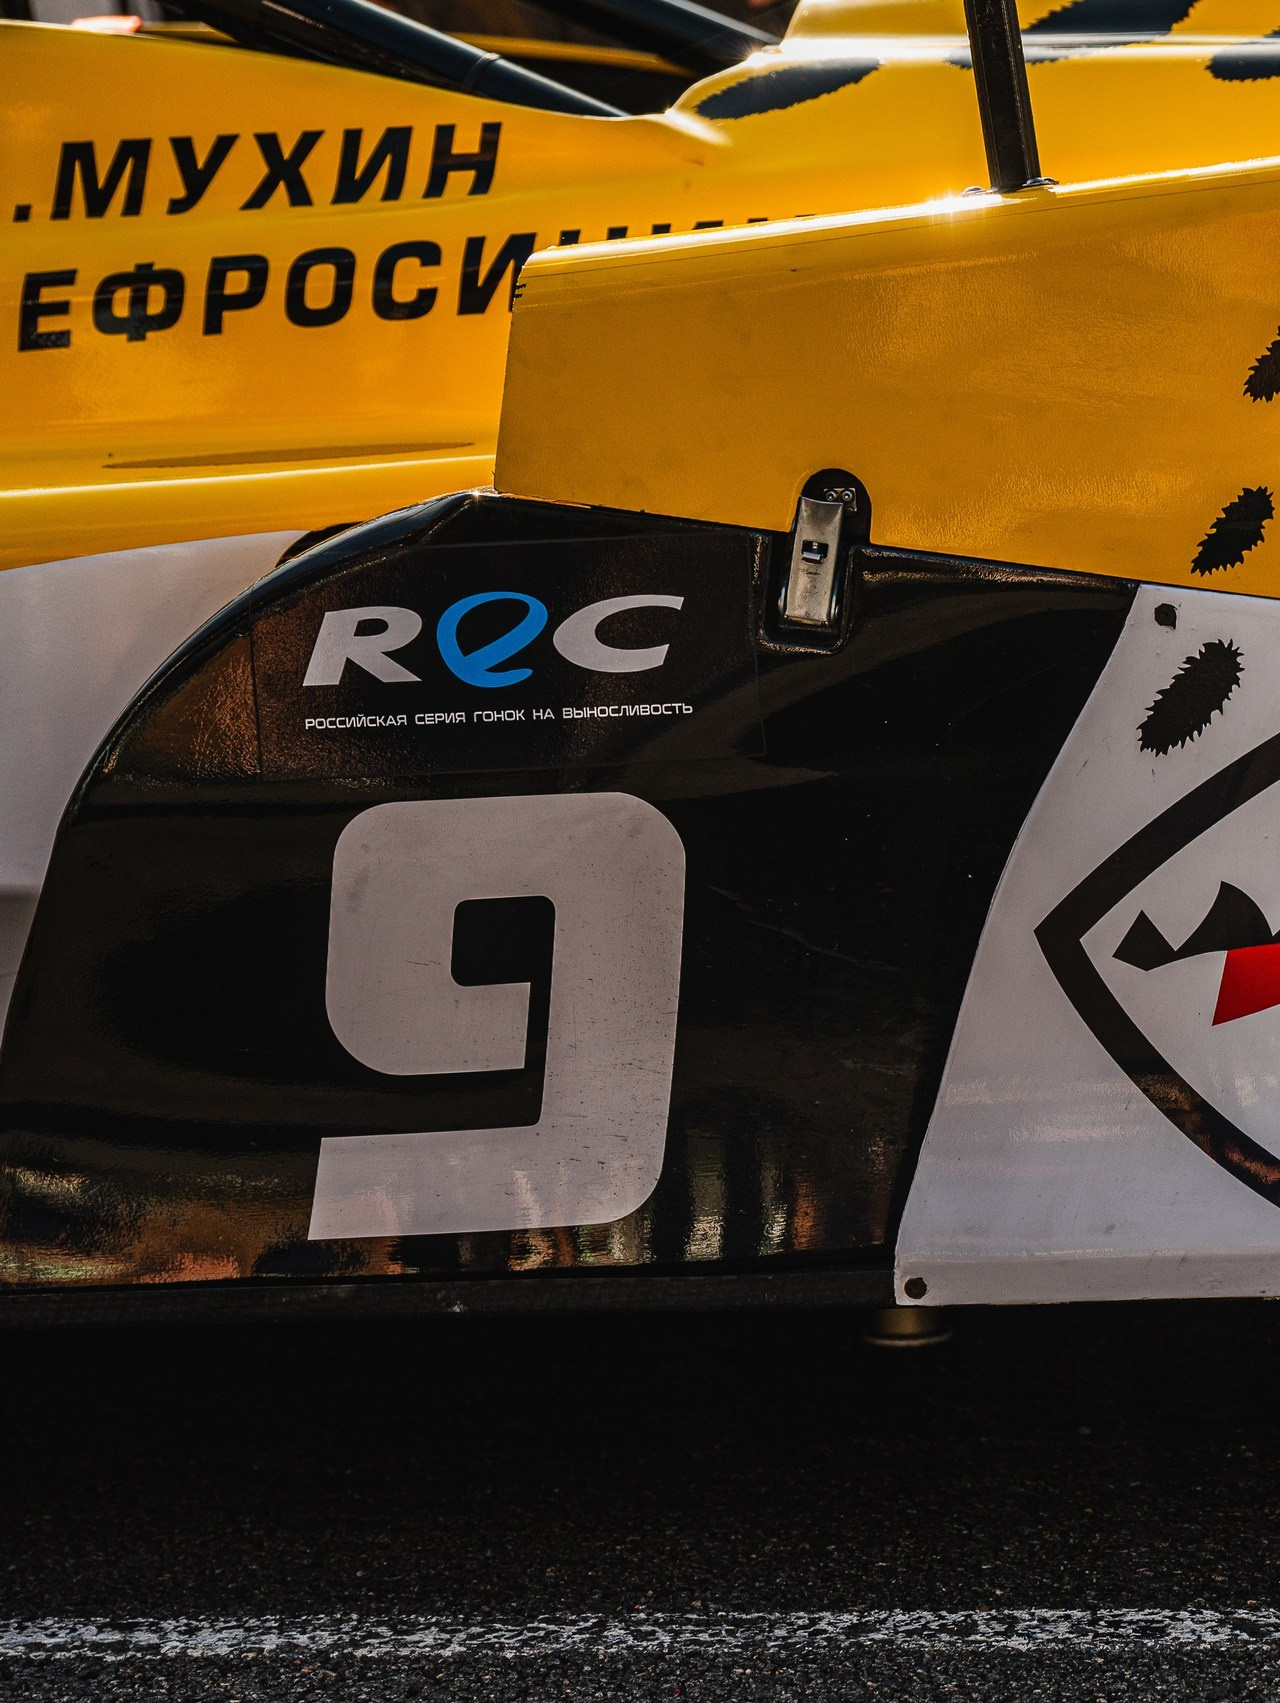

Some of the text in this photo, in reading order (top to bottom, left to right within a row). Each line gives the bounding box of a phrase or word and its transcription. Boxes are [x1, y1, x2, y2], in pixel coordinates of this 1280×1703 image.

[305, 702, 693, 730] РОССИЙСКАЯ СЕРИЯ ГОНОК НА ВЫНОСЛИВОСТЬ
[308, 791, 686, 1241] 9
